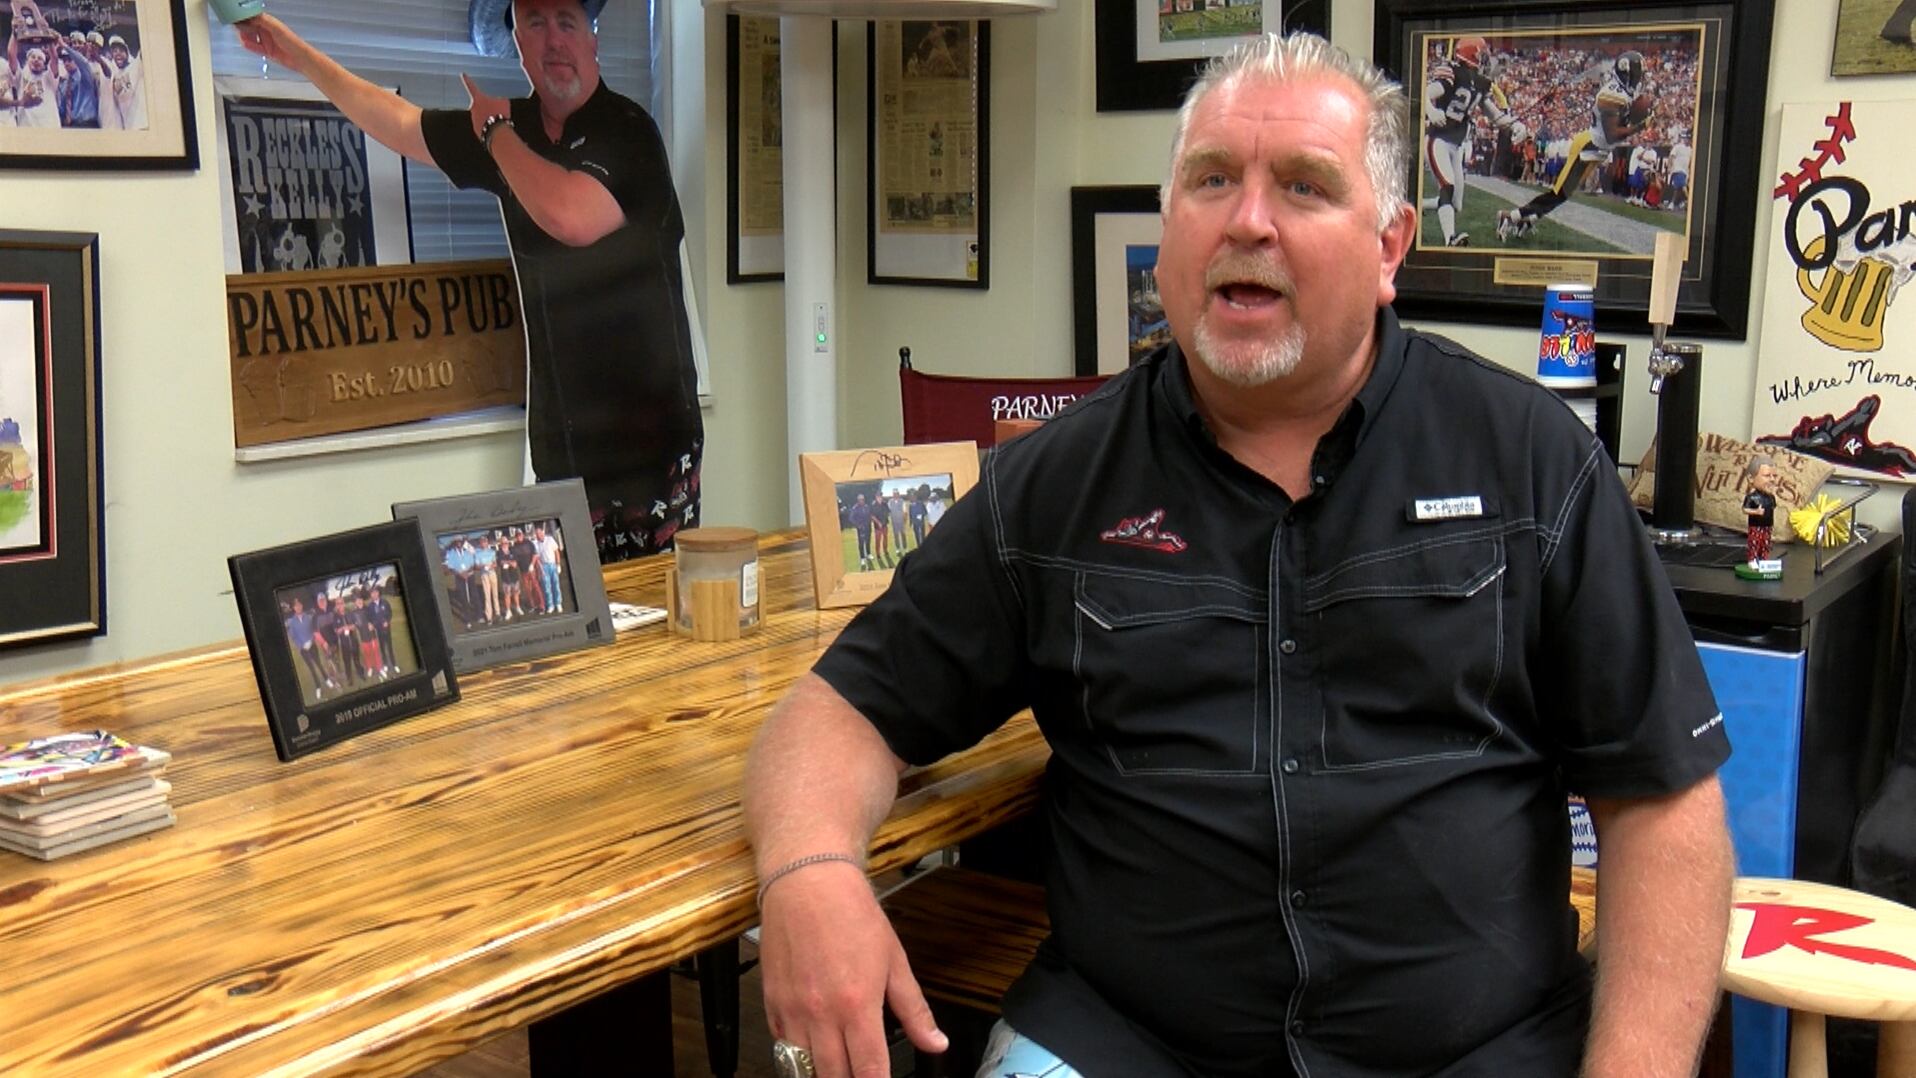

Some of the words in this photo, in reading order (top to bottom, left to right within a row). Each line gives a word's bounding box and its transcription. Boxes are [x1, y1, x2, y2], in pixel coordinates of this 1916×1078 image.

[231, 116, 365, 193] RECKLESS
[267, 168, 345, 219] KELLY
[228, 278, 432, 358] PARNEY'S
[437, 274, 514, 336] PUB
[328, 371, 385, 401] Est.
[389, 360, 455, 395] 2010
[1769, 376, 1842, 404] Where
[991, 394, 1085, 421] PARNE
[354, 699, 388, 718] OFFICIAL
[387, 688, 417, 708] PRO-AM
